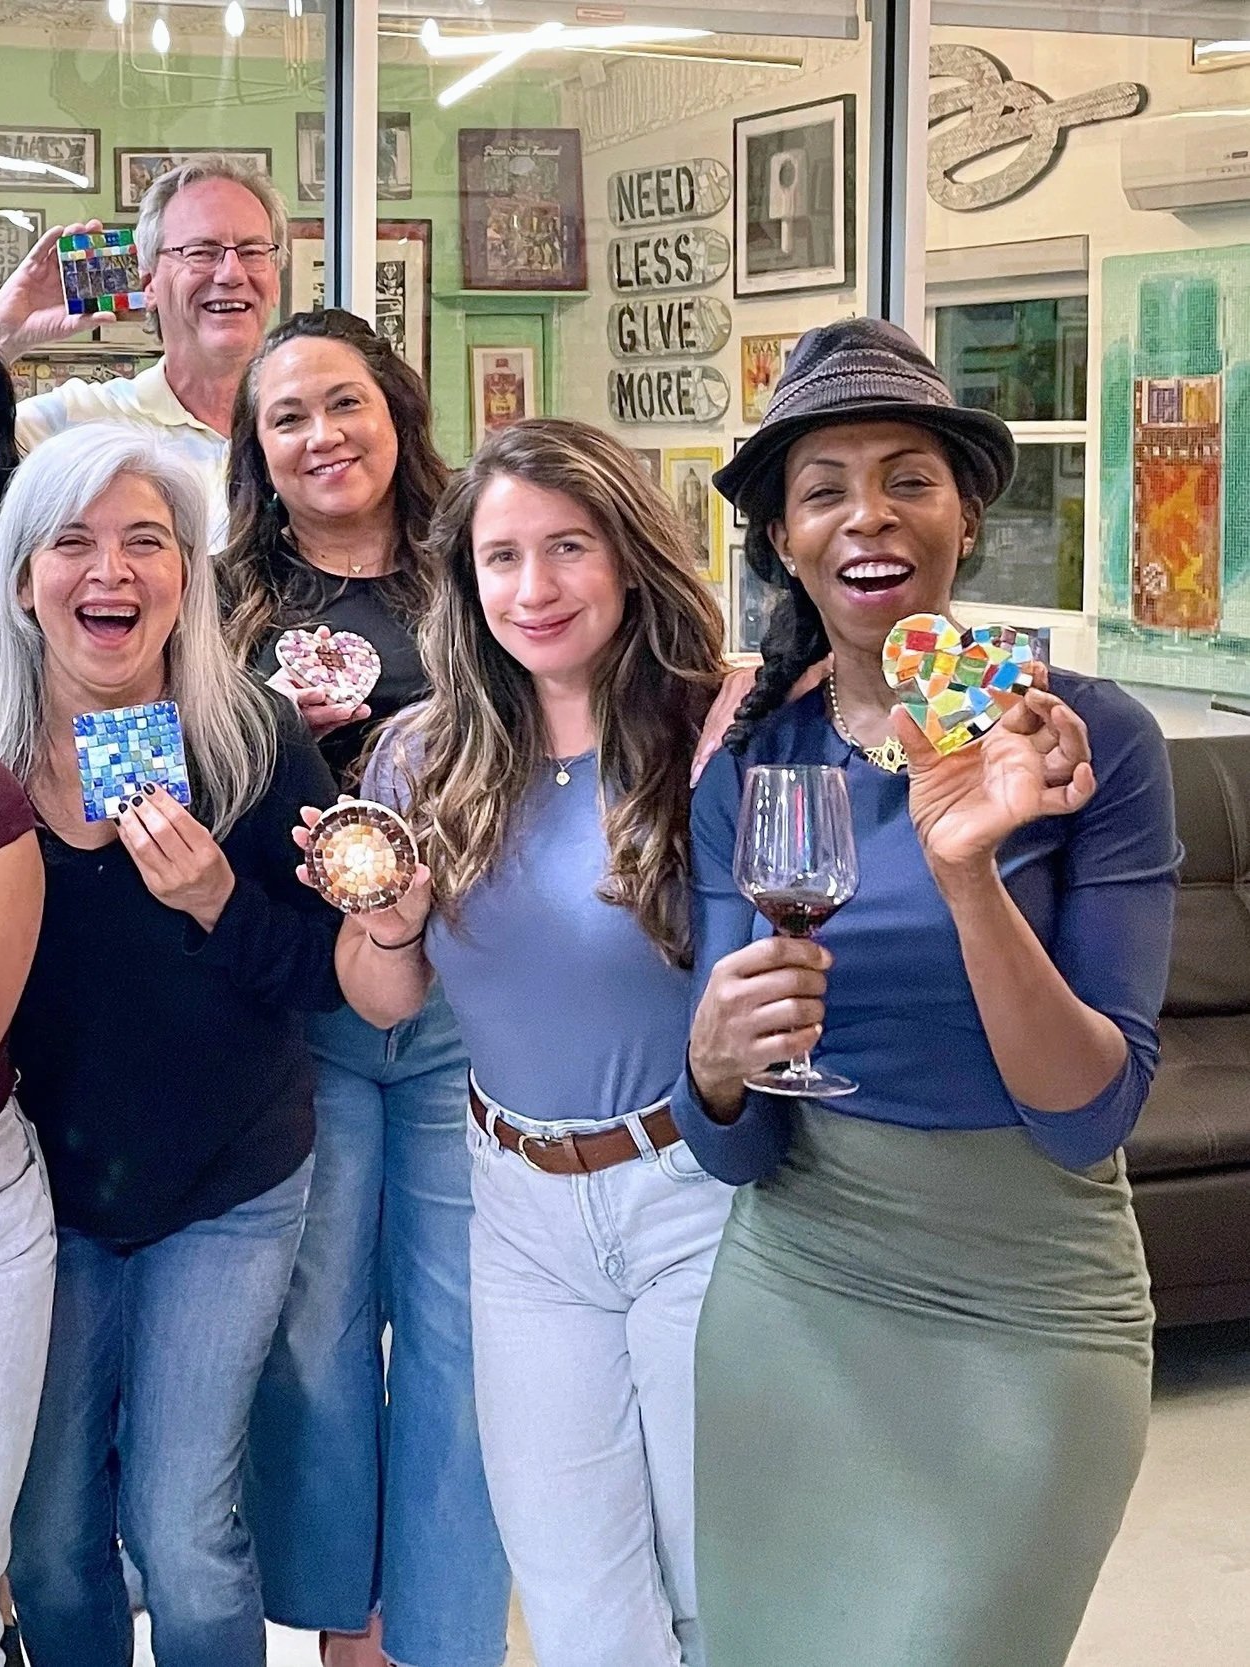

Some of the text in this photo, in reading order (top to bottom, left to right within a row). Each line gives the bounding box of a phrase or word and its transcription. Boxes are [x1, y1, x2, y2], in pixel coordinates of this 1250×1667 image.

[616, 166, 695, 222] NEED
[615, 233, 693, 289] LESS
[618, 302, 697, 353] GIVE
[746, 341, 779, 355] TEXAS
[616, 365, 696, 420] MORE
